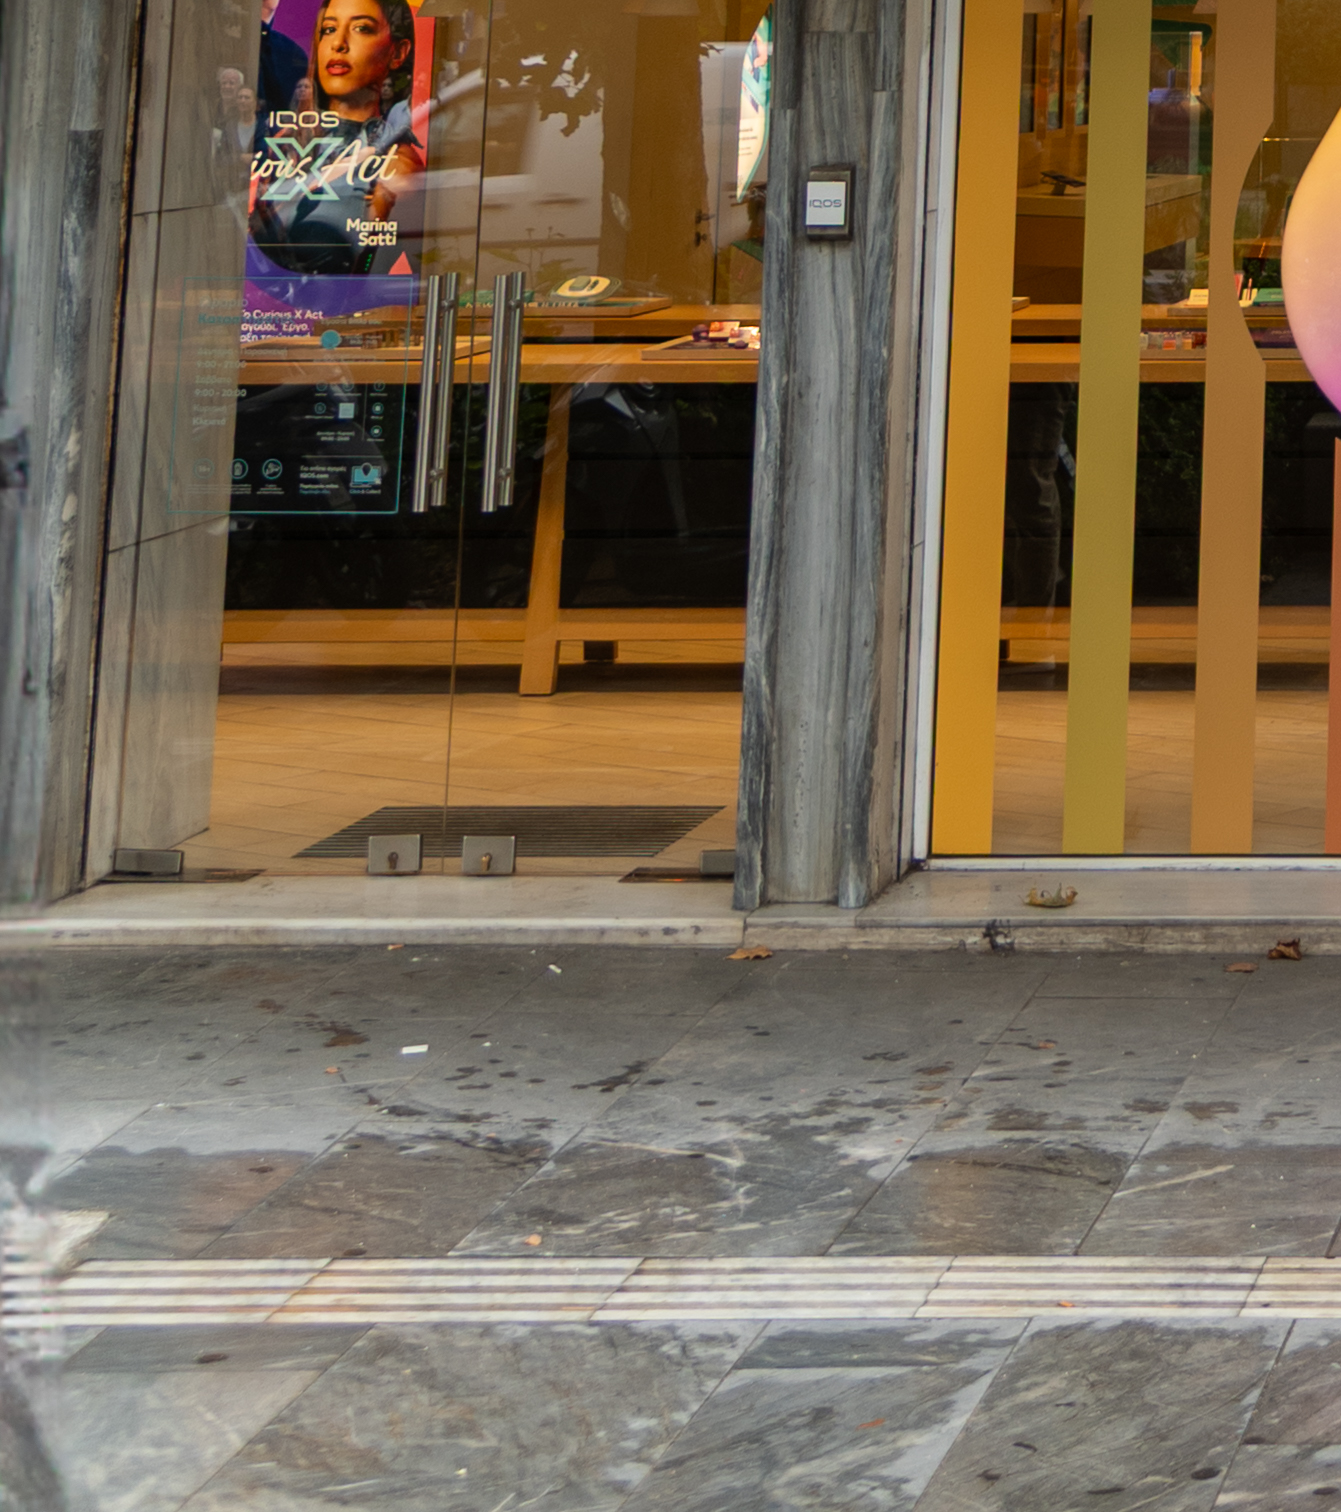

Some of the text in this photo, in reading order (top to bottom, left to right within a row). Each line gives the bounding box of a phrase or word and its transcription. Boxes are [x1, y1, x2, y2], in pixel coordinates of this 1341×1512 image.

[269, 110, 340, 130] IQOS
[250, 150, 313, 182] ious
[317, 139, 399, 188] Act
[808, 198, 843, 209] IQOS
[346, 217, 398, 233] Marina
[357, 232, 398, 247] Satti
[294, 309, 302, 319] X
[304, 309, 324, 319] Act
